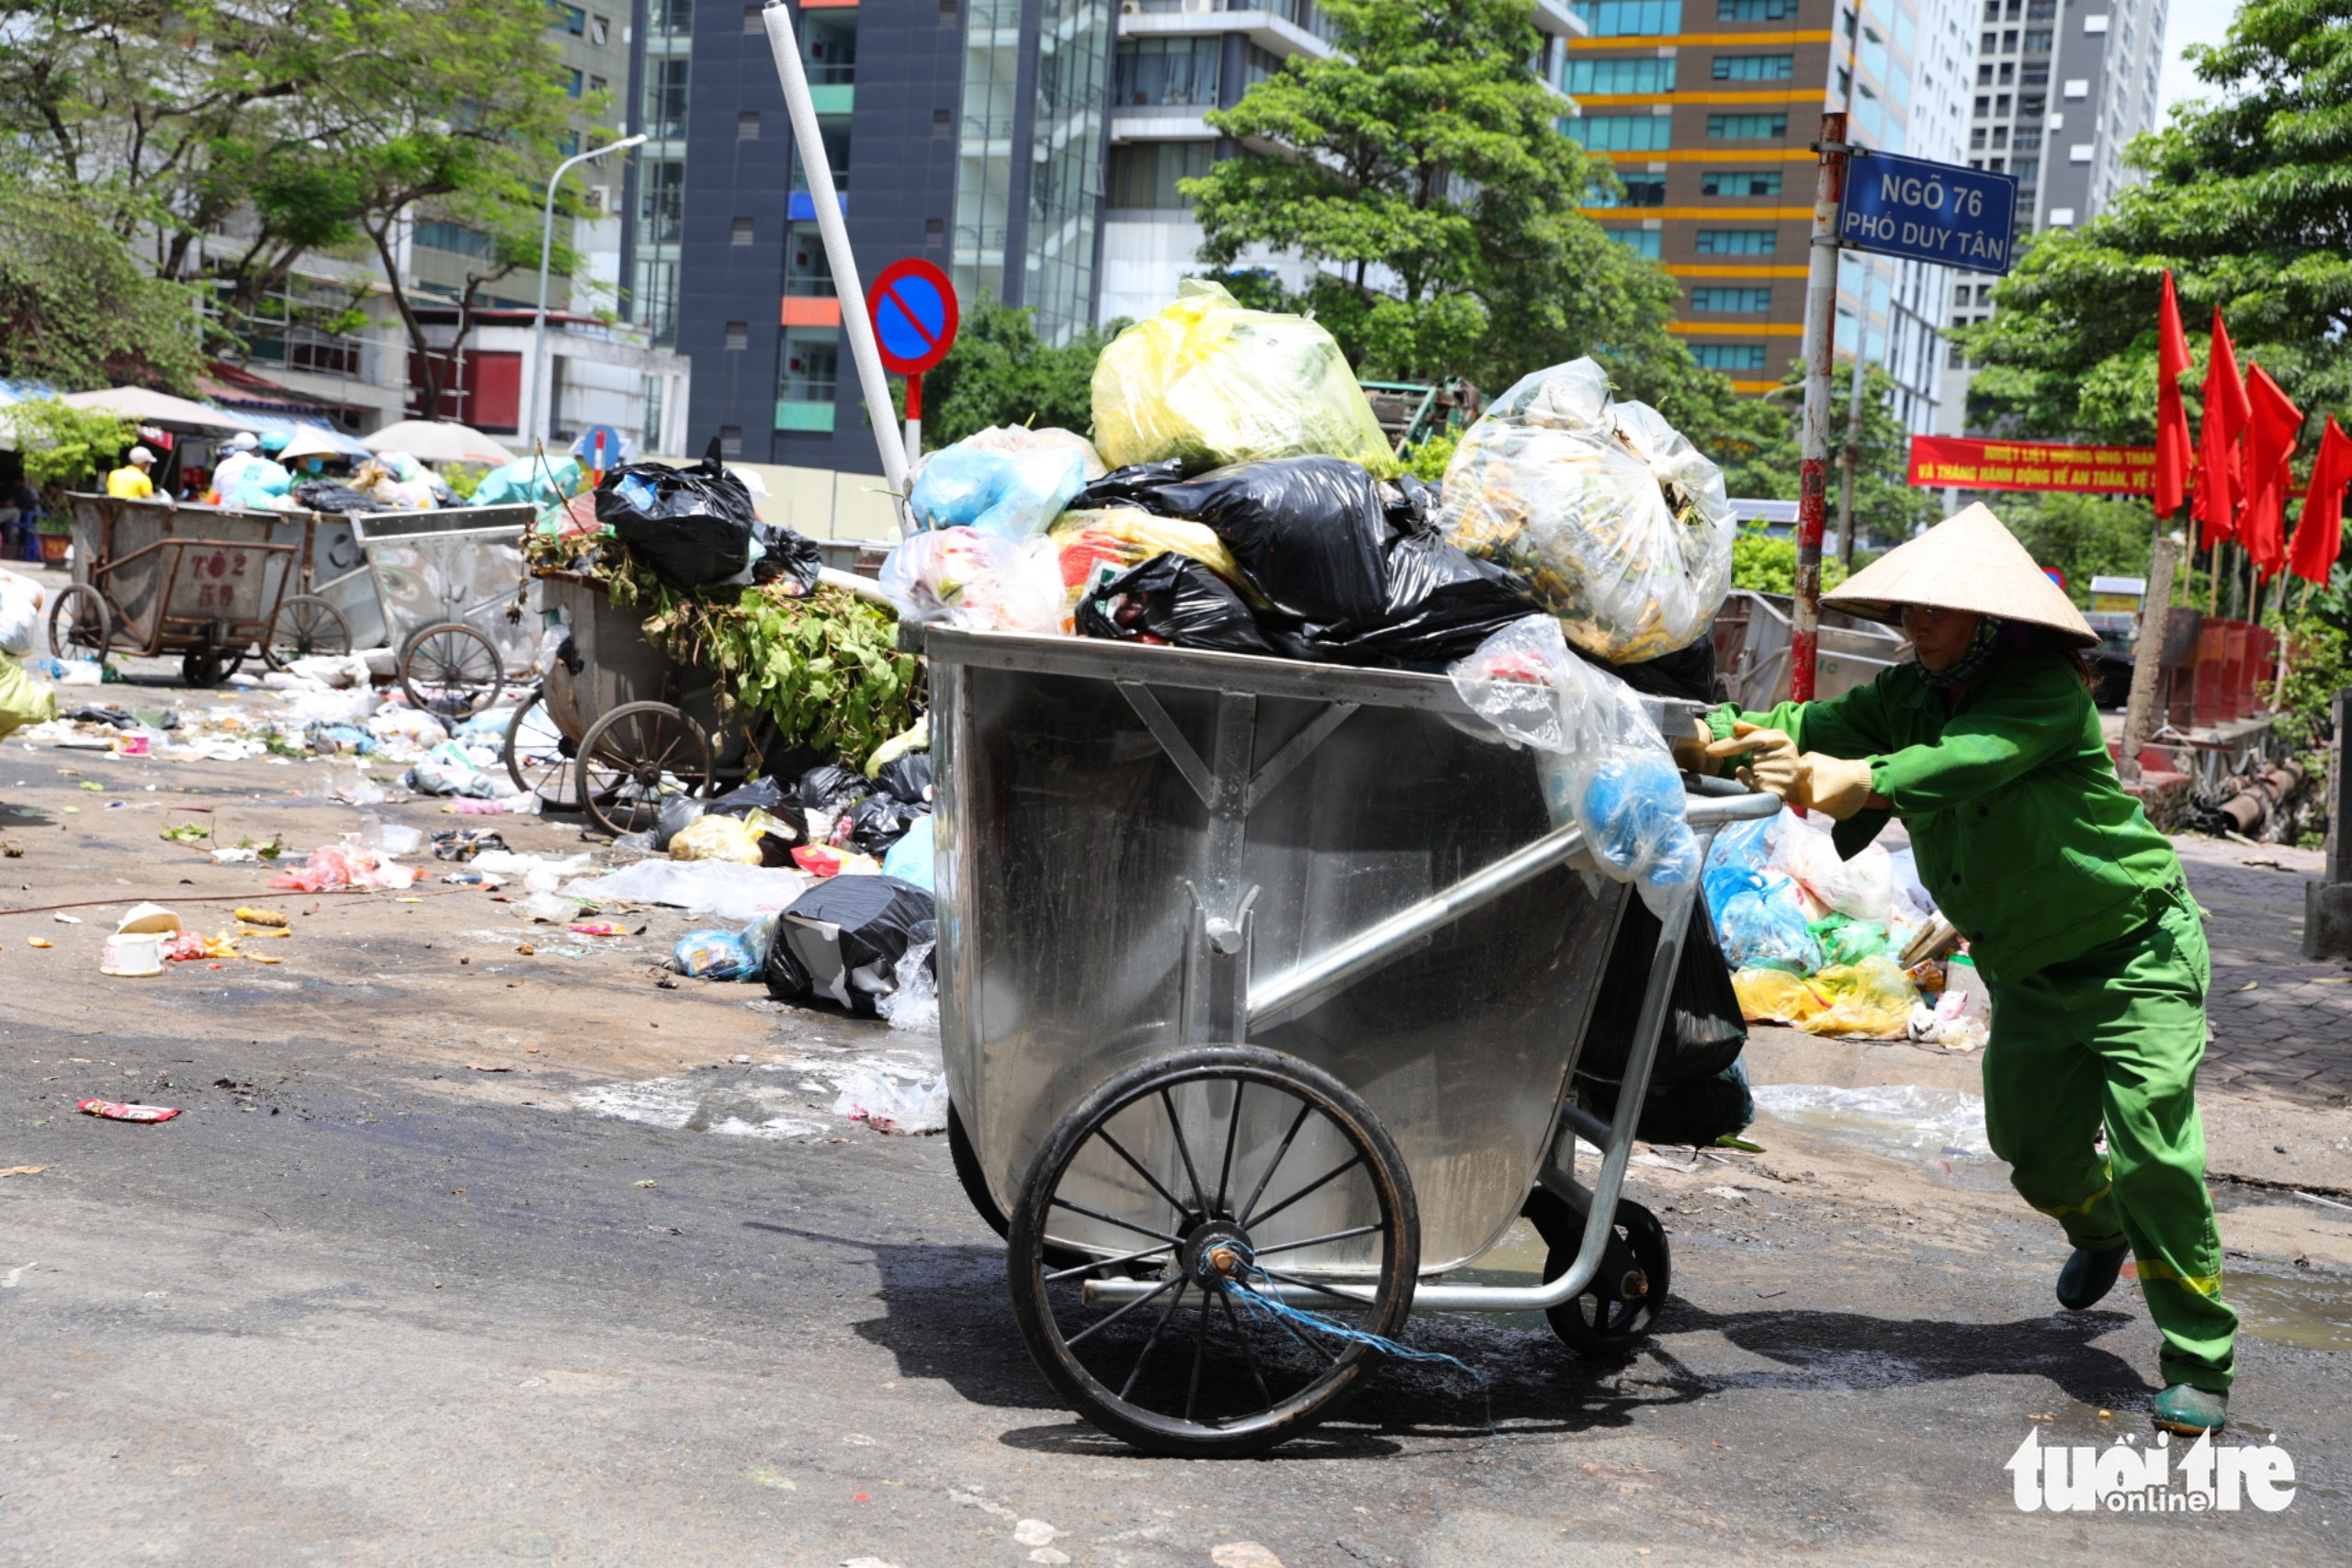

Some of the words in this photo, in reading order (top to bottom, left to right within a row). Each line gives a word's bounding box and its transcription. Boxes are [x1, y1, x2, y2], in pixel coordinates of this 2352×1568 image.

[1881, 173, 1944, 210] NGÕ
[1952, 186, 1984, 218] 76
[1845, 210, 1896, 241] PHỐ
[1902, 221, 1951, 251] DUY
[1957, 230, 2005, 261] TÂN
[2125, 449, 2155, 466] THÁN
[1917, 460, 1934, 479] VÀ
[1937, 461, 1977, 481] THÁNG
[2071, 469, 2090, 486] AN
[231, 552, 248, 577] 2
